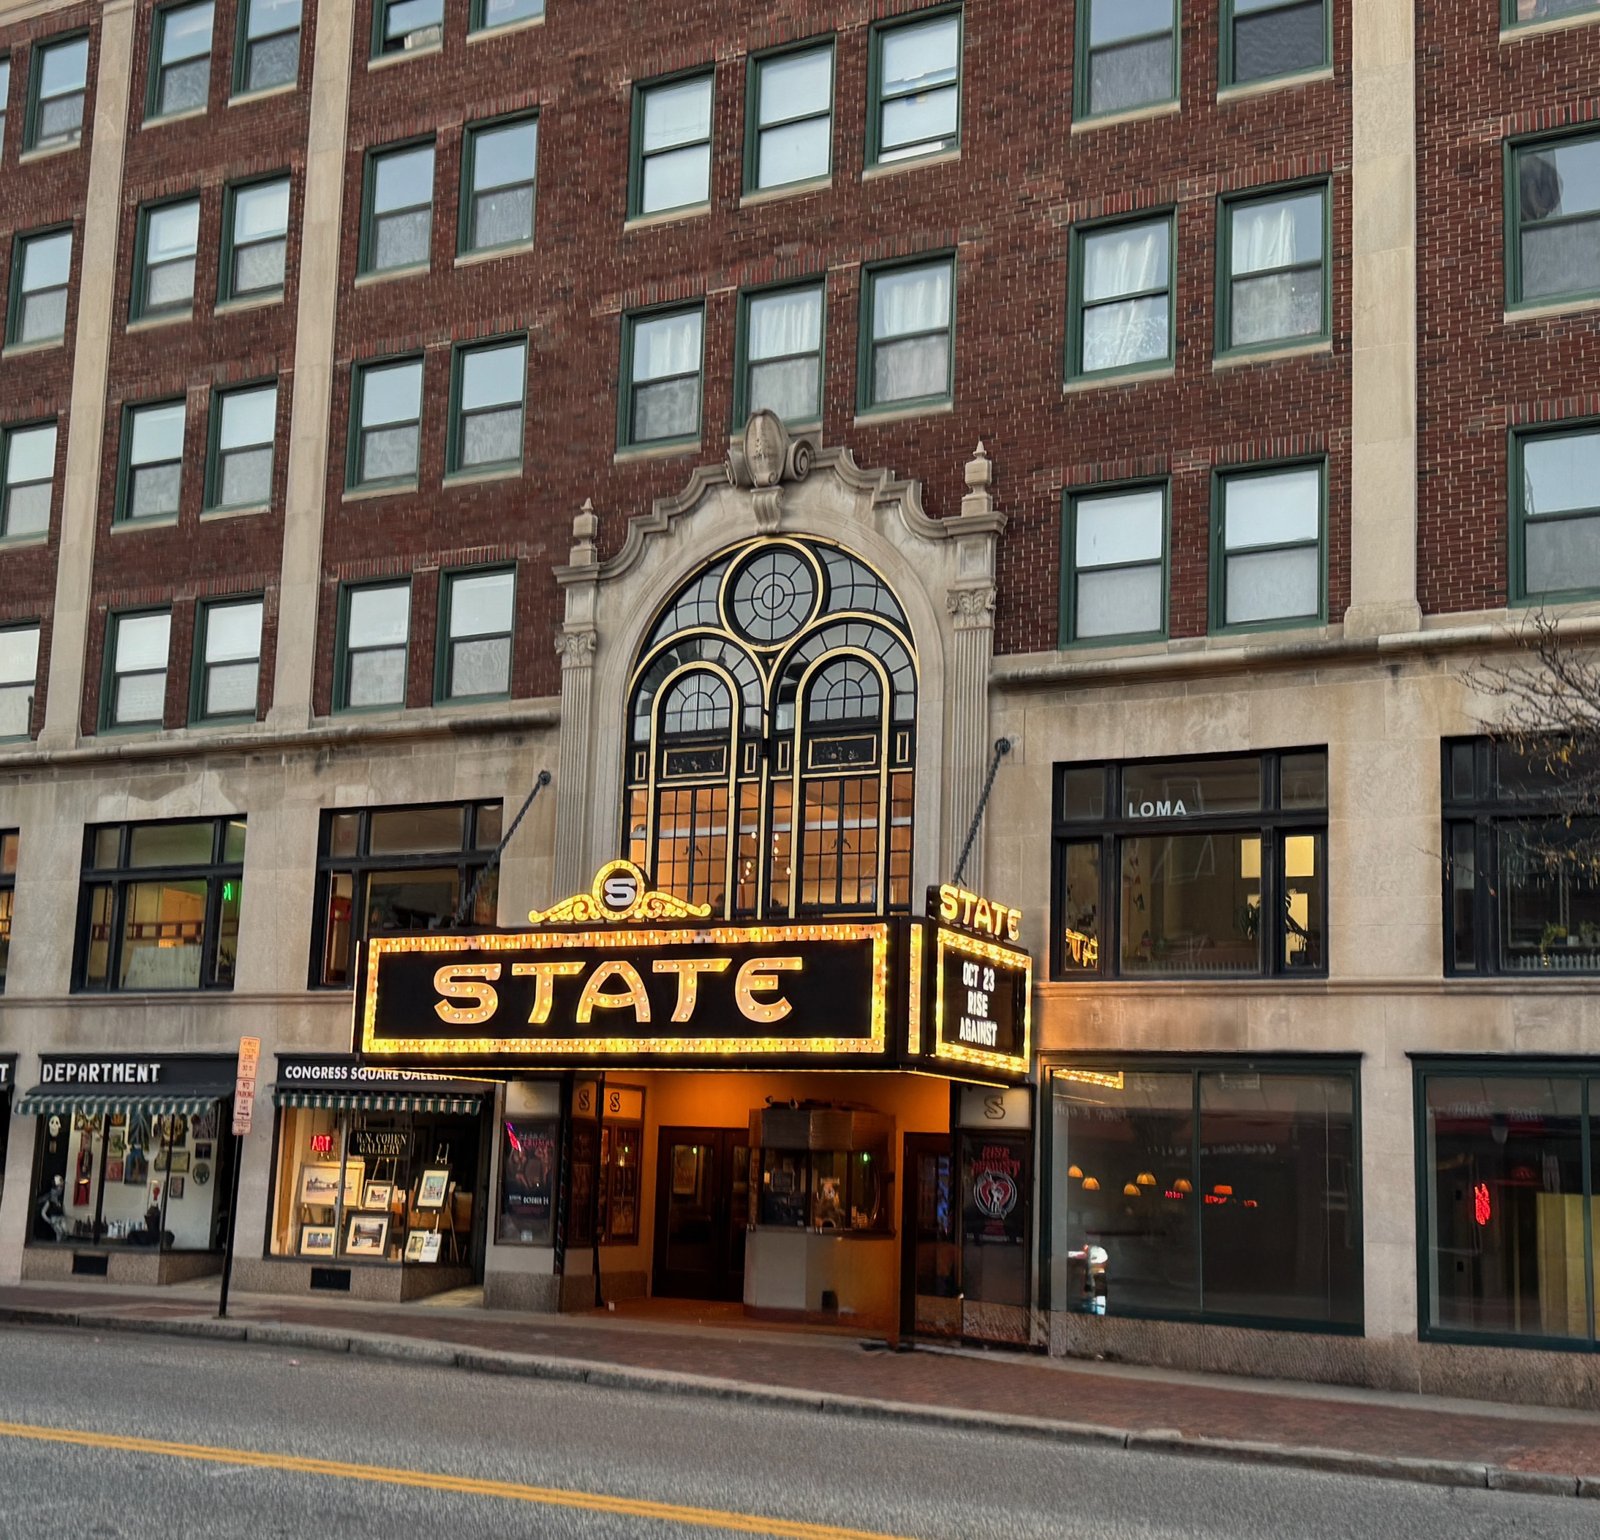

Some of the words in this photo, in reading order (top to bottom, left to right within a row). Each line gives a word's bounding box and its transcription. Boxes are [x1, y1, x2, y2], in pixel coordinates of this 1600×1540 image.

[1128, 799, 1187, 818] LOMA
[604, 877, 636, 906] S
[939, 883, 1022, 942] STATE
[962, 961, 980, 988] OCT
[982, 967, 995, 992] 23
[433, 956, 803, 1025] STATE
[967, 991, 989, 1018] RISE
[959, 1017, 998, 1047] AGAINST
[42, 1063, 161, 1083] DEPARTMENT
[285, 1065, 348, 1079] CONGRESS
[350, 1067, 399, 1081] SQUARE
[610, 1092, 620, 1112] S
[984, 1094, 1006, 1120] S
[311, 1135, 331, 1151] ART
[359, 1143, 401, 1155] GALLERY
[375, 1132, 408, 1145] COHEN
